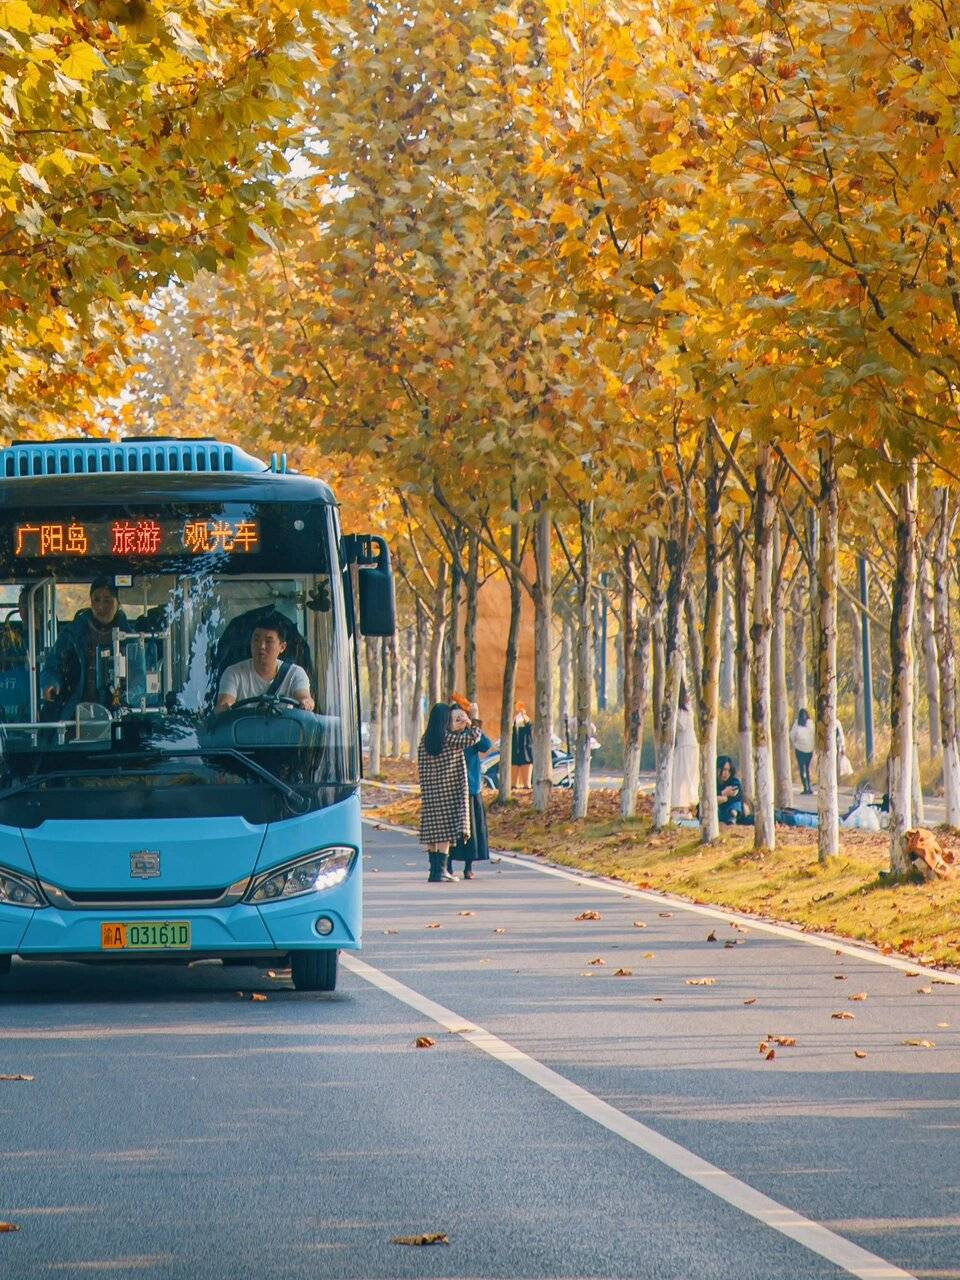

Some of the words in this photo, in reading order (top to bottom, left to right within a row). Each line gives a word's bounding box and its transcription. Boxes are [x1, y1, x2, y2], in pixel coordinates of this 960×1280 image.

[14, 522, 88, 556] 广阳岛
[111, 521, 161, 554] 旅游
[184, 519, 259, 553] 观光车
